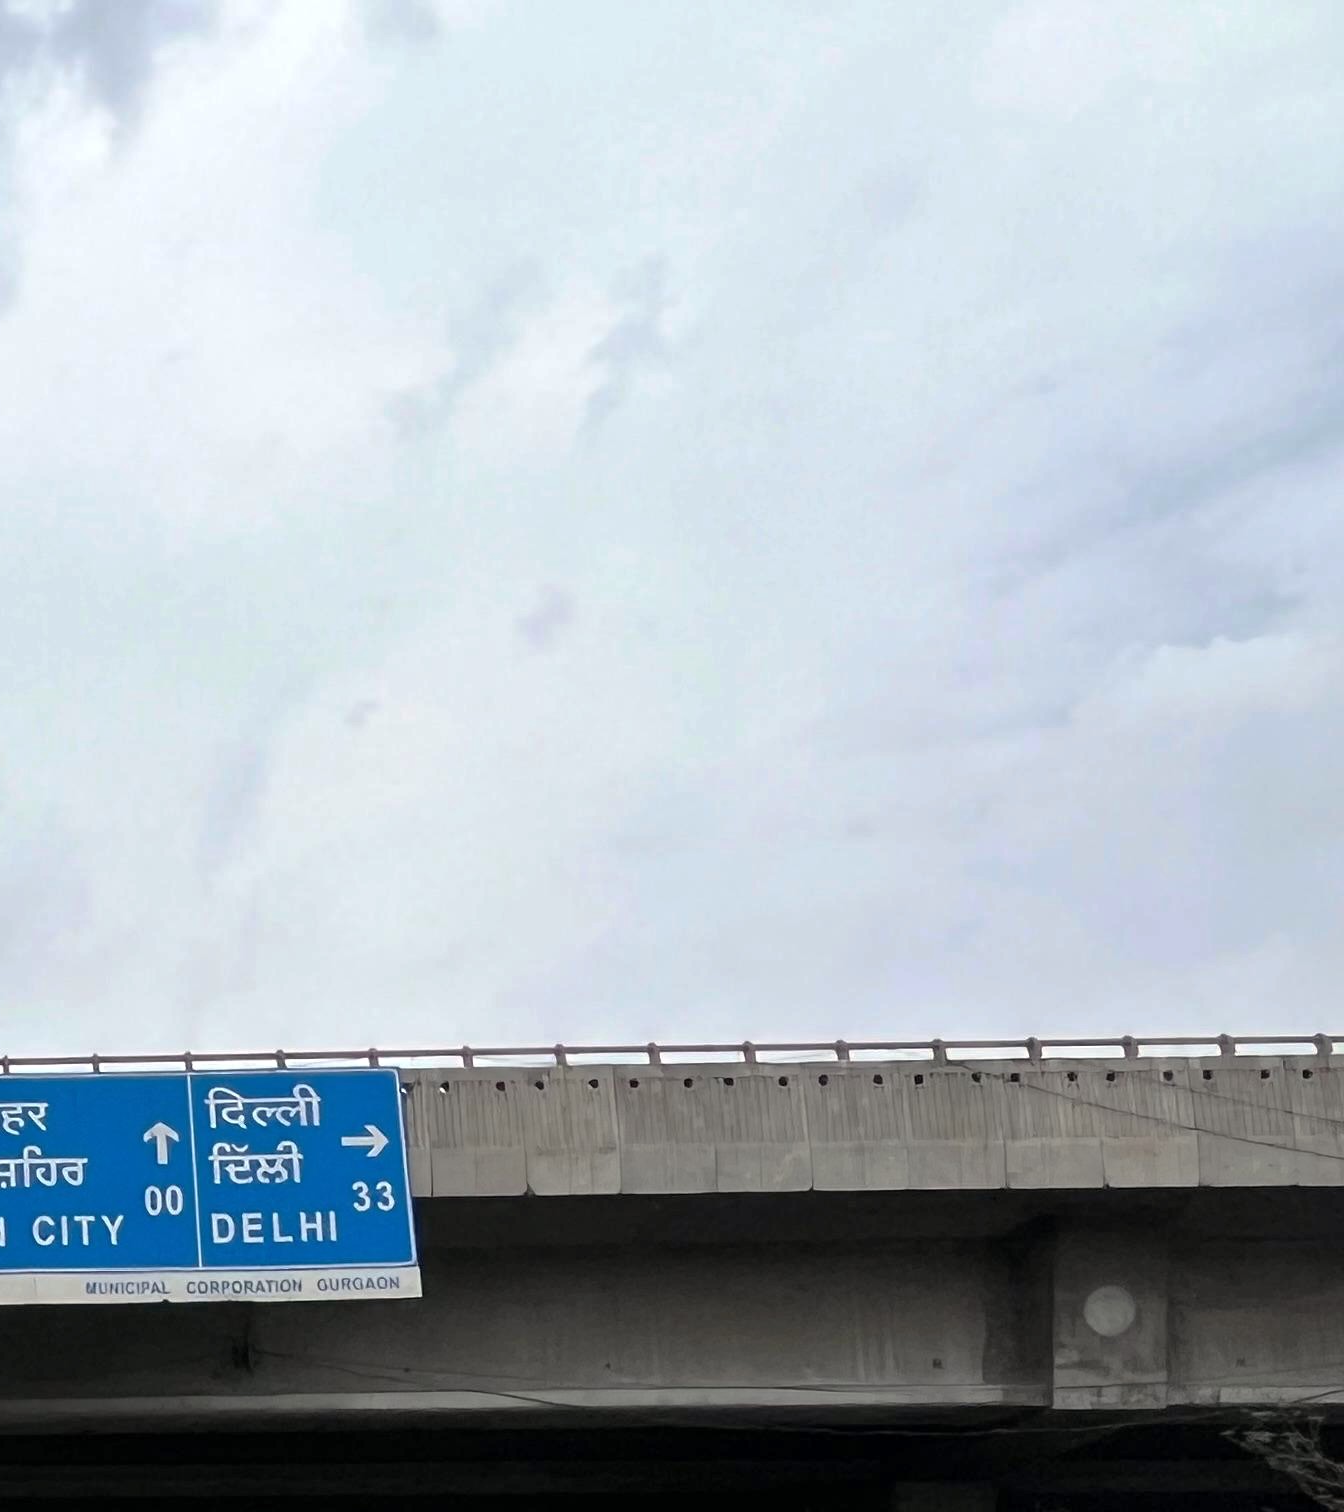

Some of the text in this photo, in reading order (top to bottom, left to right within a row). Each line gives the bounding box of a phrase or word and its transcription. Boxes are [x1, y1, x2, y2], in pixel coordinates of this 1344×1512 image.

[204, 1084, 321, 1129] दिल्ली
[208, 1141, 303, 1184] ਦਿੱਲੀ
[144, 1185, 184, 1216] 00
[351, 1181, 396, 1212] 33
[32, 1215, 124, 1246] CITY
[211, 1211, 337, 1244] DELHI
[85, 1276, 400, 1295] MUNICIPAL CORPORATION GURGAON
